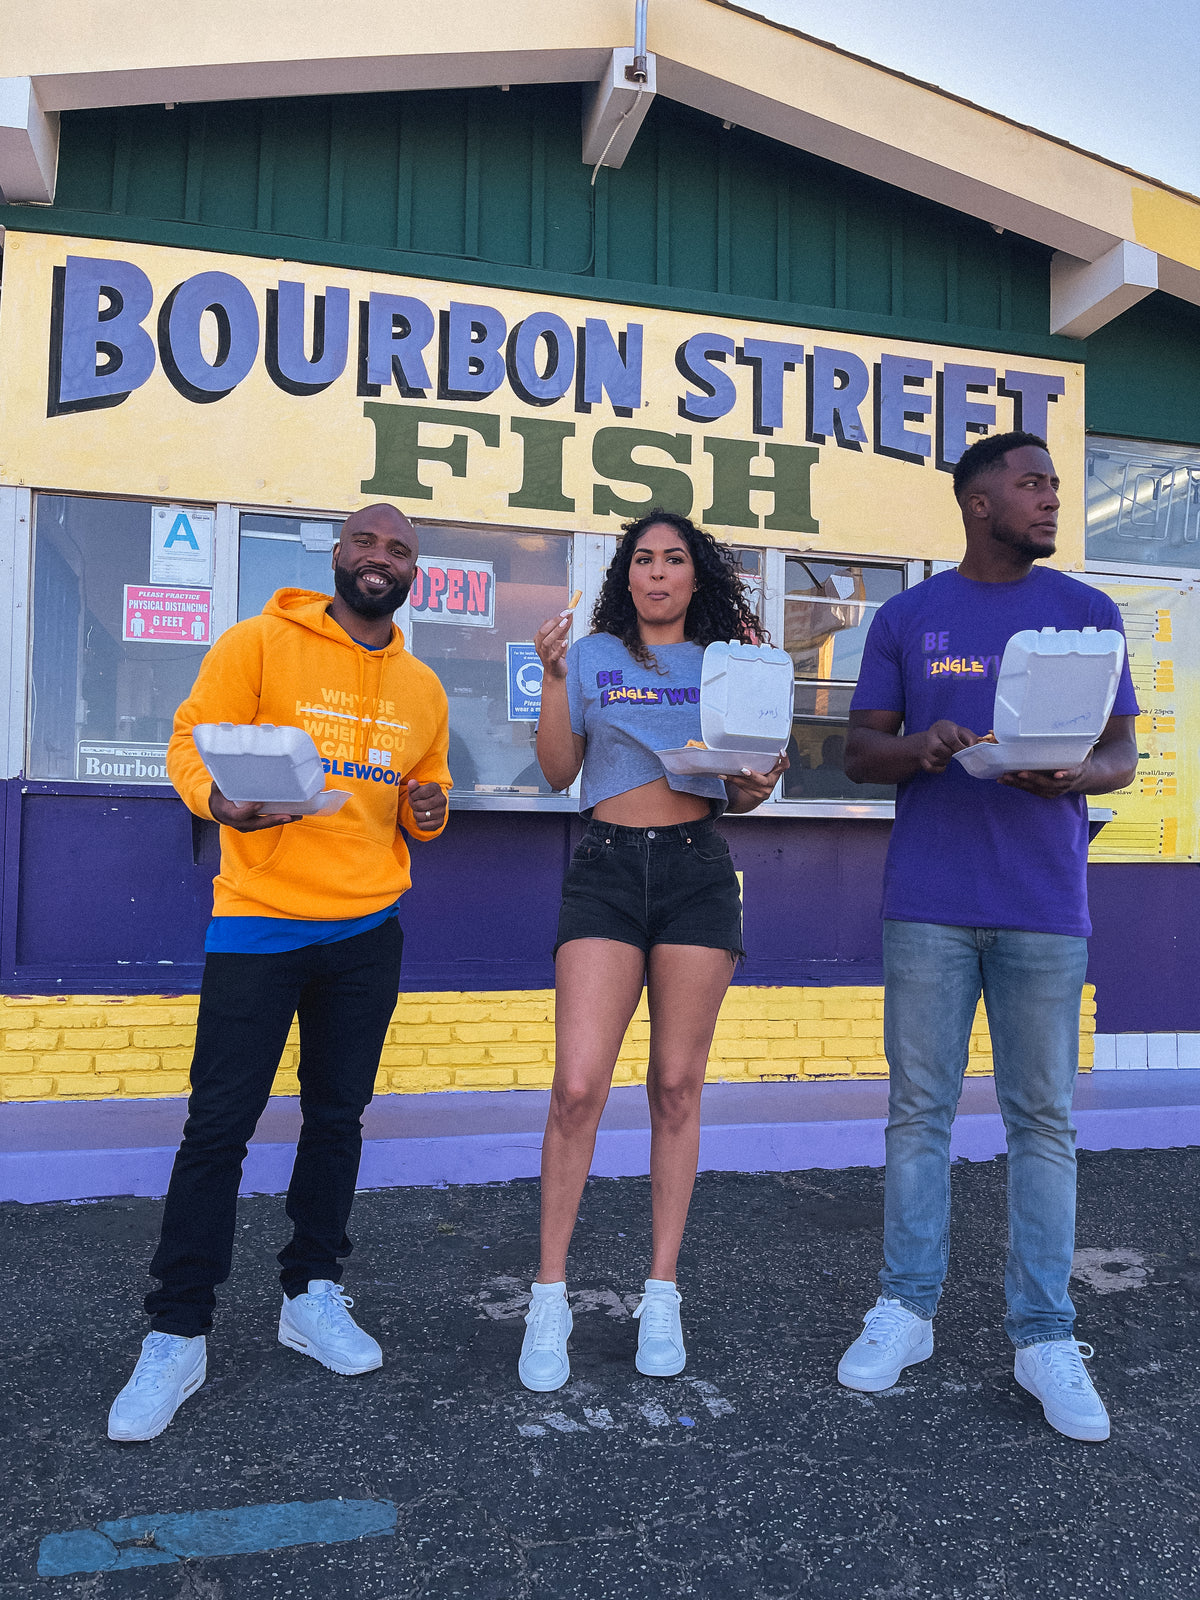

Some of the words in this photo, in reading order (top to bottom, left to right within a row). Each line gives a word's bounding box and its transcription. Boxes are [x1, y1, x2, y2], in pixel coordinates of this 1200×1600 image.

[49, 255, 643, 418] BOURBON
[675, 332, 1065, 473] STREET
[361, 401, 819, 535] FISH
[163, 513, 200, 550] A
[138, 591, 164, 599] PLEASE
[165, 592, 200, 600] PRACTICE
[128, 600, 164, 611] PHYSICAL
[165, 601, 208, 613] DISTANCING
[153, 615, 160, 626] 6
[162, 616, 184, 627] FEET
[923, 631, 949, 652] BE
[930, 657, 984, 674] INGLE
[596, 670, 623, 688] BE
[321, 688, 367, 707] WHY
[372, 698, 395, 716] BE
[607, 688, 659, 702] INGLE
[372, 732, 406, 752] YOU
[368, 748, 391, 767] BE
